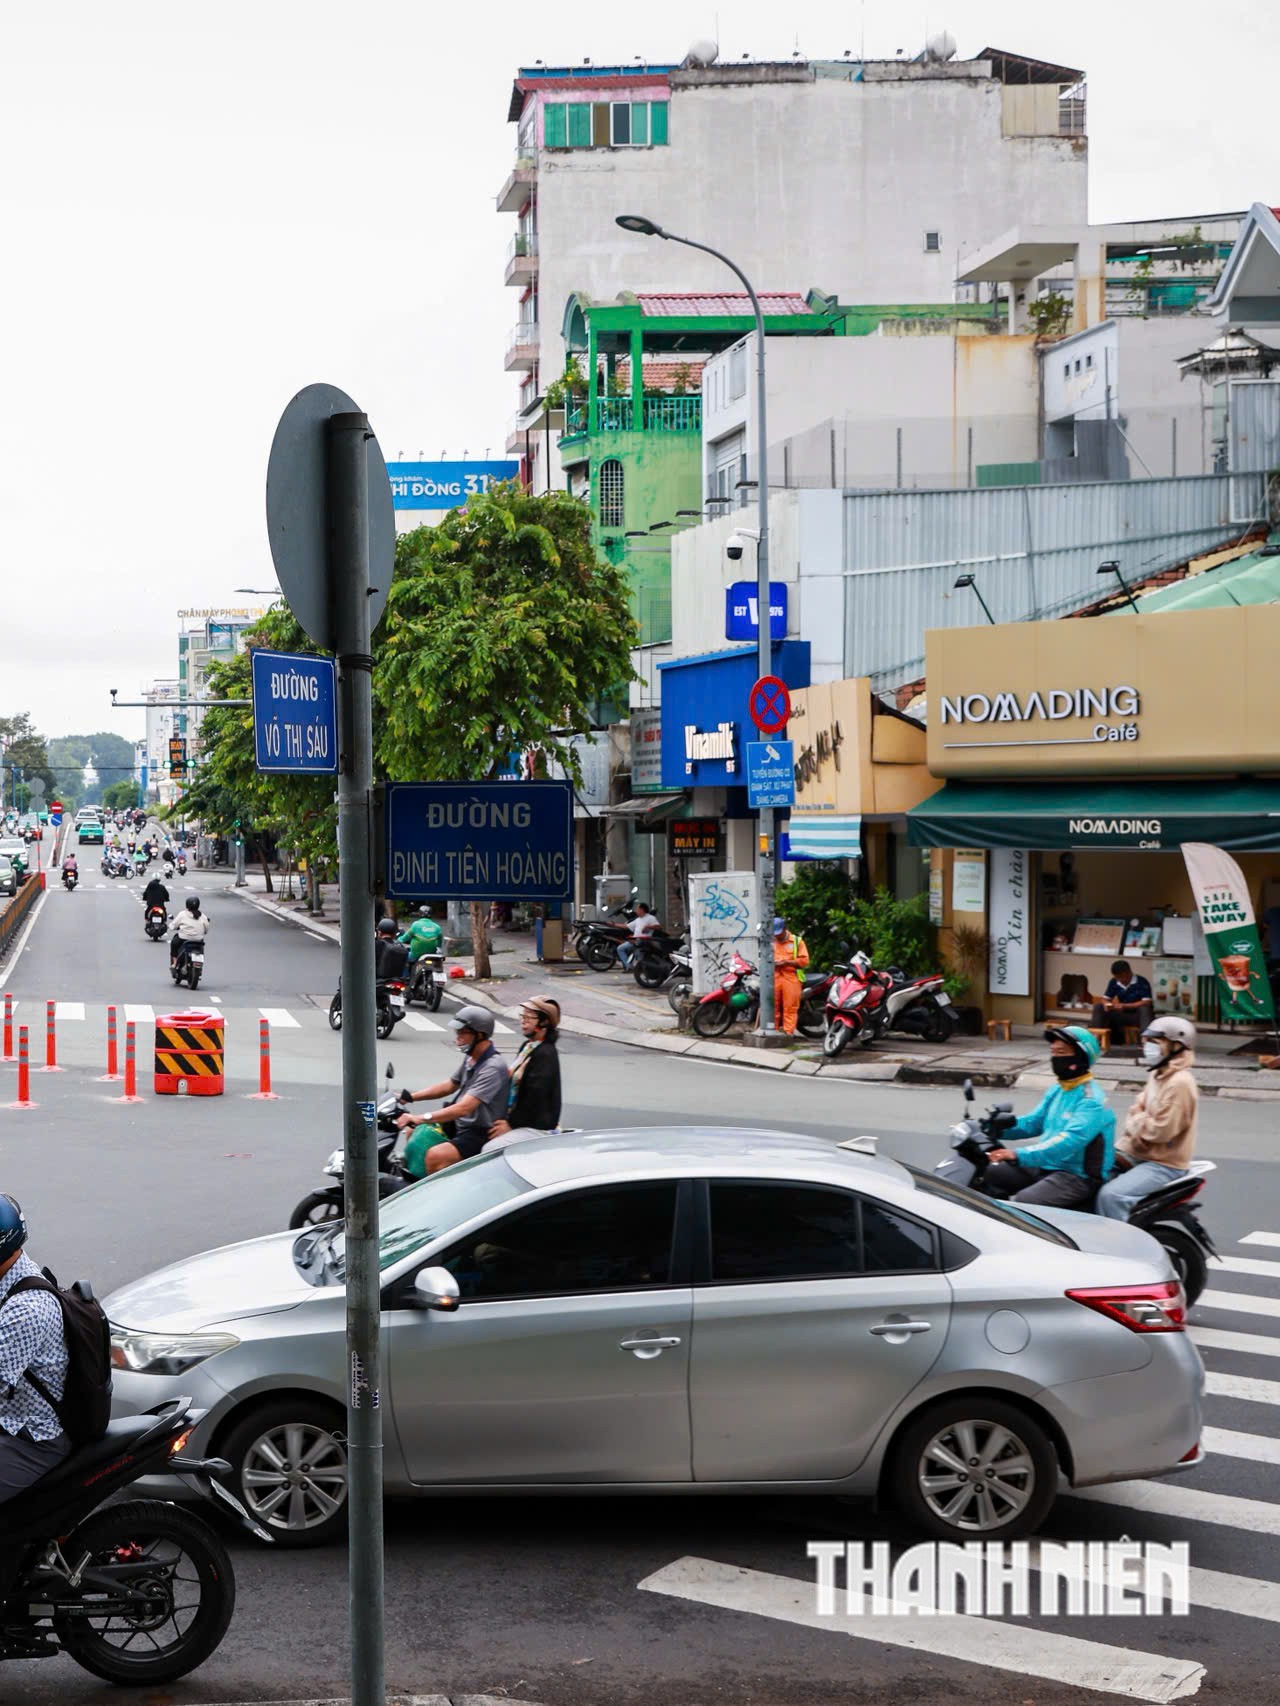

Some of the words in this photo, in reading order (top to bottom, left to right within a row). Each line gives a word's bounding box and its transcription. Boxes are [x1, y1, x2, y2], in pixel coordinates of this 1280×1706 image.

[391, 483, 408, 496] HI
[411, 478, 461, 497] ĐỒNG
[734, 606, 747, 617] EST
[769, 606, 784, 617] 976
[271, 669, 318, 702] ĐƯỜNG
[940, 686, 1141, 724] NOMADING
[265, 716, 280, 758] VÕ
[284, 724, 303, 765] THỊ
[306, 715, 328, 758] SÁU
[685, 722, 735, 761] Vinamilk
[1092, 723, 1138, 743] Café
[426, 797, 531, 828] ĐƯỜNG
[1069, 820, 1161, 834] NOMADING
[1139, 841, 1161, 850] Café
[393, 852, 438, 884] ĐINH
[445, 844, 489, 885] TIÊN
[496, 843, 566, 885] HOÀNG
[1008, 850, 1024, 898] chào
[1201, 901, 1241, 914] TAKE
[1203, 912, 1247, 925] AWAY
[1007, 908, 1023, 947] Xin
[997, 937, 1008, 985] NOMAD
